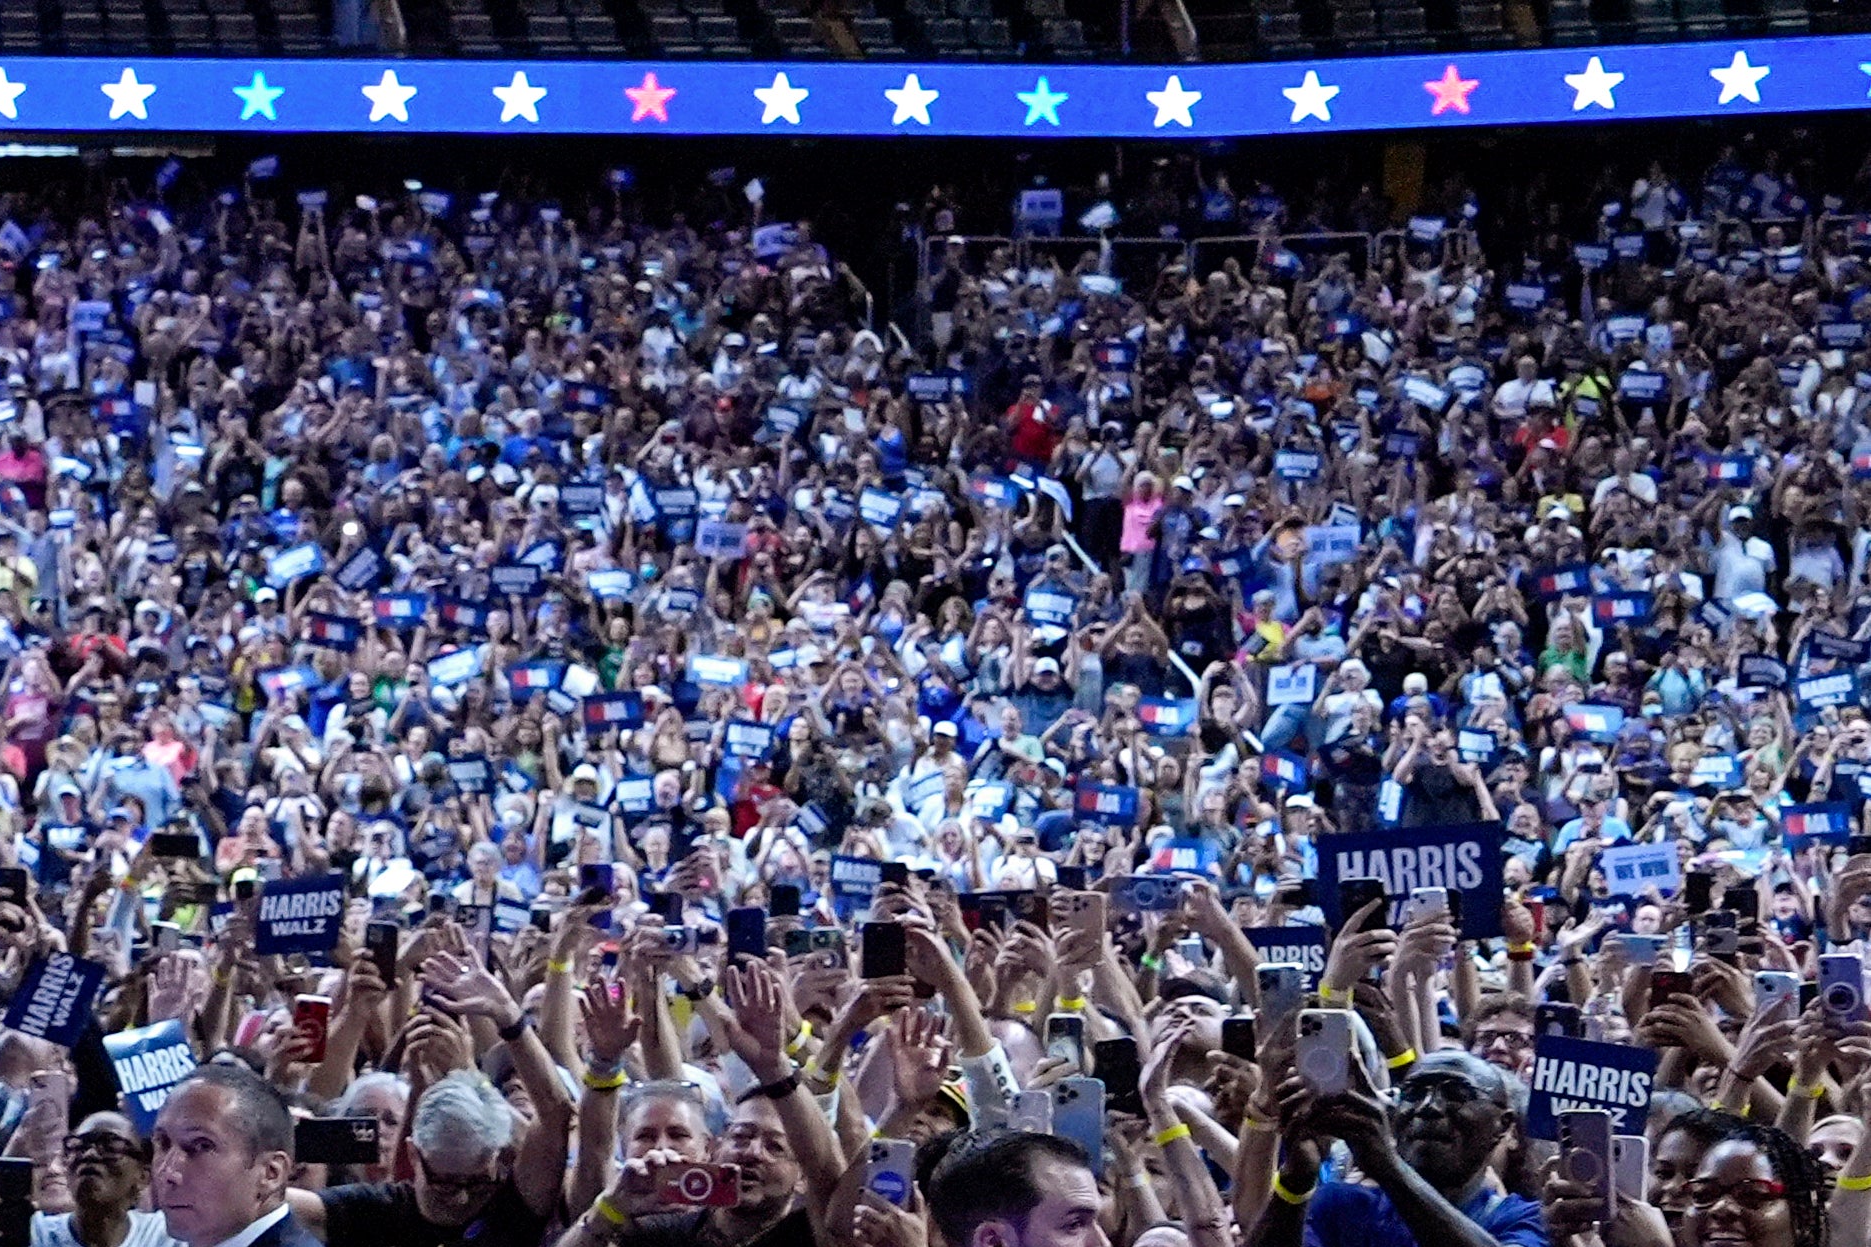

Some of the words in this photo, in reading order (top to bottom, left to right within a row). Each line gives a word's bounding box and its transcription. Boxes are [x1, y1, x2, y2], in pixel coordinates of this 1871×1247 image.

[1337, 842, 1483, 895] HARRIS
[260, 889, 341, 921] HARRIS
[270, 918, 326, 937] WALZ
[1257, 944, 1325, 972] ARRIS
[20, 952, 75, 1036] HARRIS
[52, 971, 86, 1027] WALZ
[115, 1043, 196, 1094] HARRIS
[1534, 1056, 1650, 1107] HARRIS
[138, 1085, 175, 1112] WA
